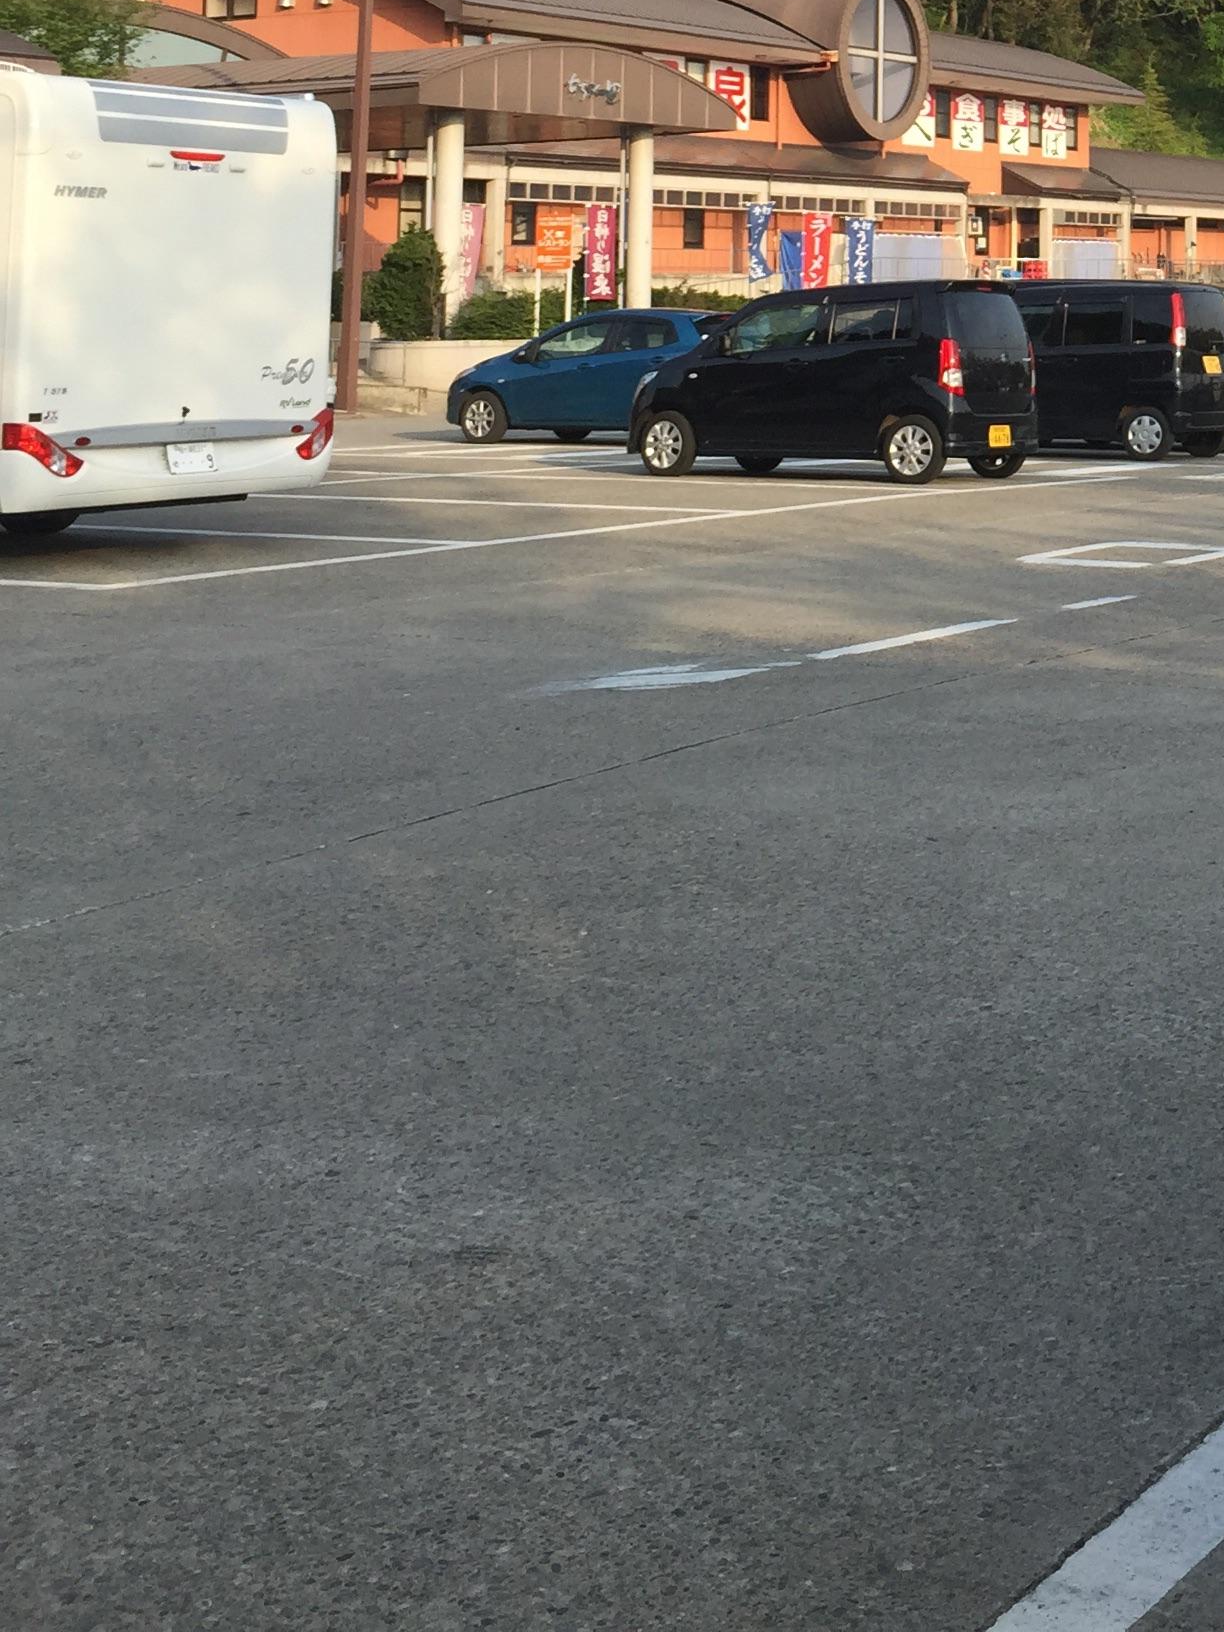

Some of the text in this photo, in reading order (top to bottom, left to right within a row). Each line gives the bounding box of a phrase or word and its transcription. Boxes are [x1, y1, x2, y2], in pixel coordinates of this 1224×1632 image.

[53, 184, 109, 199] HYMER
[591, 210, 613, 295] 日帰り温泉
[809, 219, 826, 288] ラーメン
